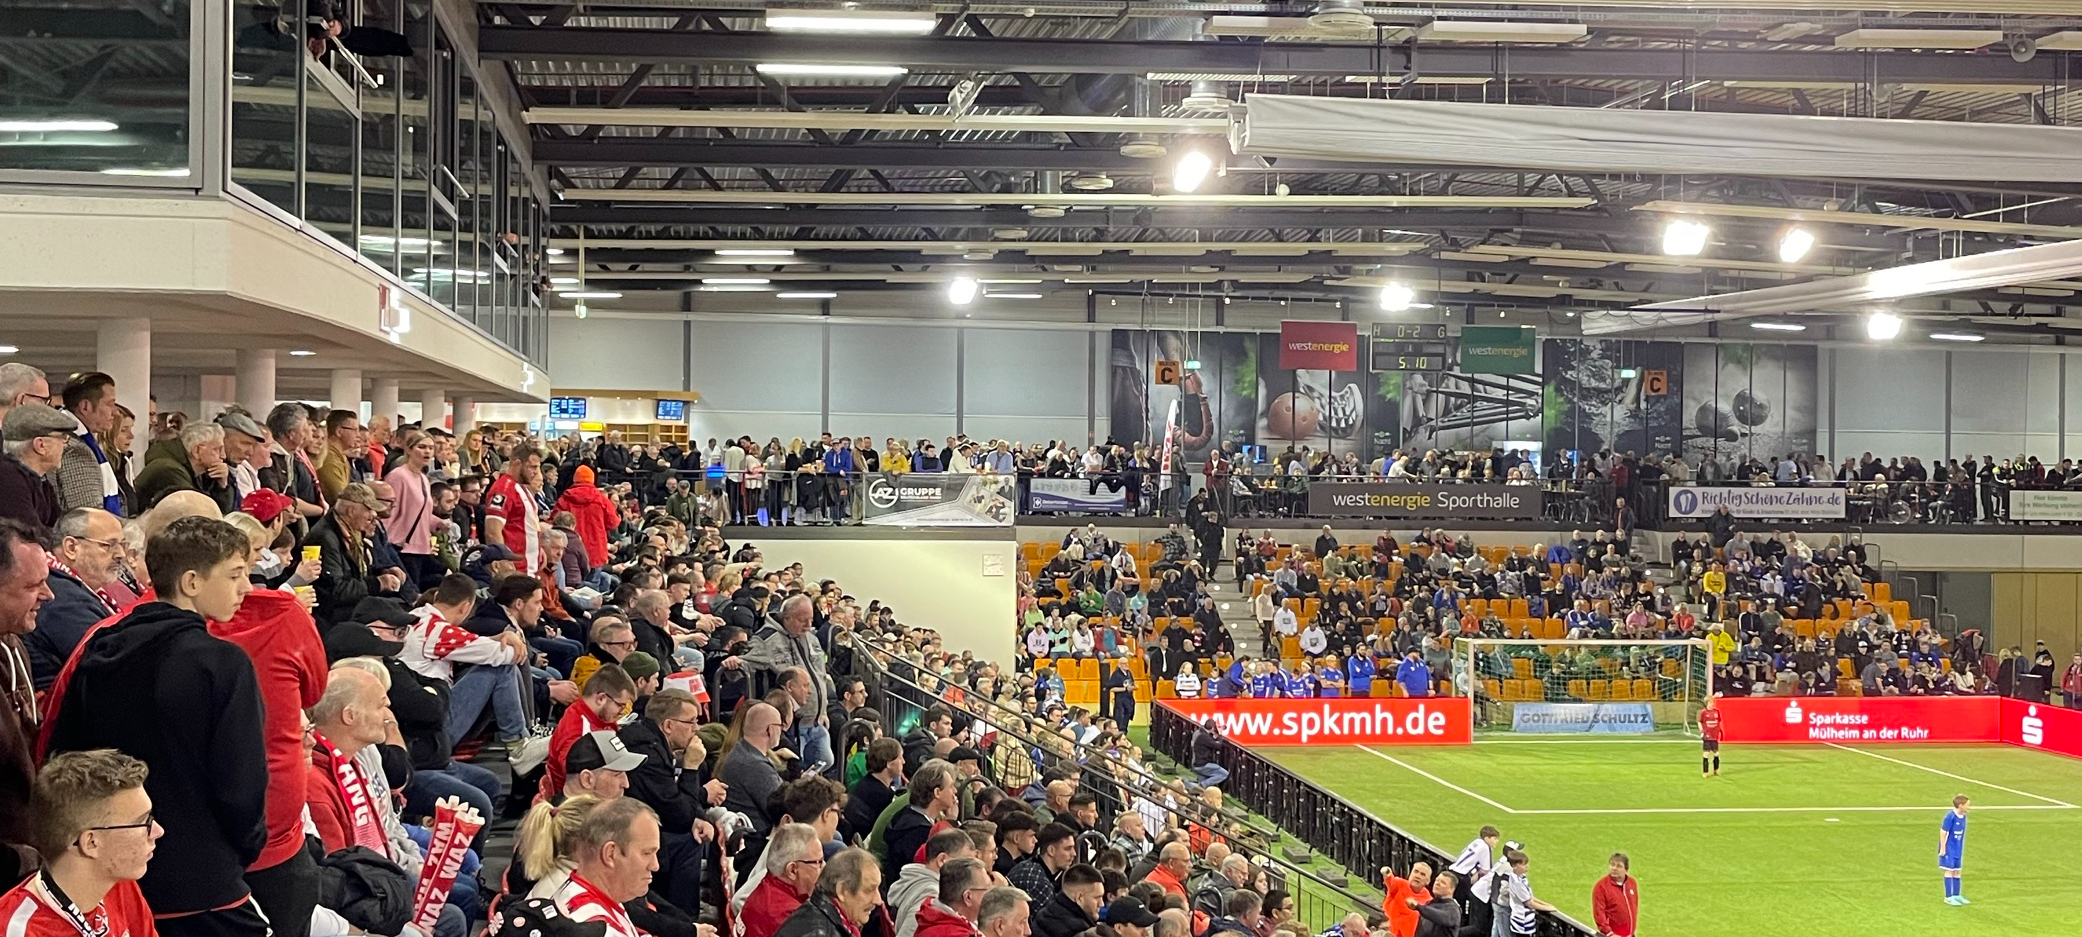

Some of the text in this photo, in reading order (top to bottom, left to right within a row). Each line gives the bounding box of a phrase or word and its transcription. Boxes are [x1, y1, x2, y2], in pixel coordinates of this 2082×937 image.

[1373, 325, 1380, 337] H
[1437, 326, 1445, 338] G
[1288, 341, 1349, 353] westenergie
[1468, 345, 1528, 358] westenergie
[1160, 367, 1173, 384] C
[1650, 377, 1661, 393] C
[900, 487, 942, 496] GRUPPE
[1332, 492, 1520, 510] westenergie Sporthalle
[1520, 713, 1649, 724] GOTTFRIED SCHULTZ
[1808, 712, 1869, 726] Sparkasse
[1808, 727, 1929, 739] Mülheim an der Ruhr
[427, 822, 455, 867] WAZ
[439, 832, 474, 880] WAZ
